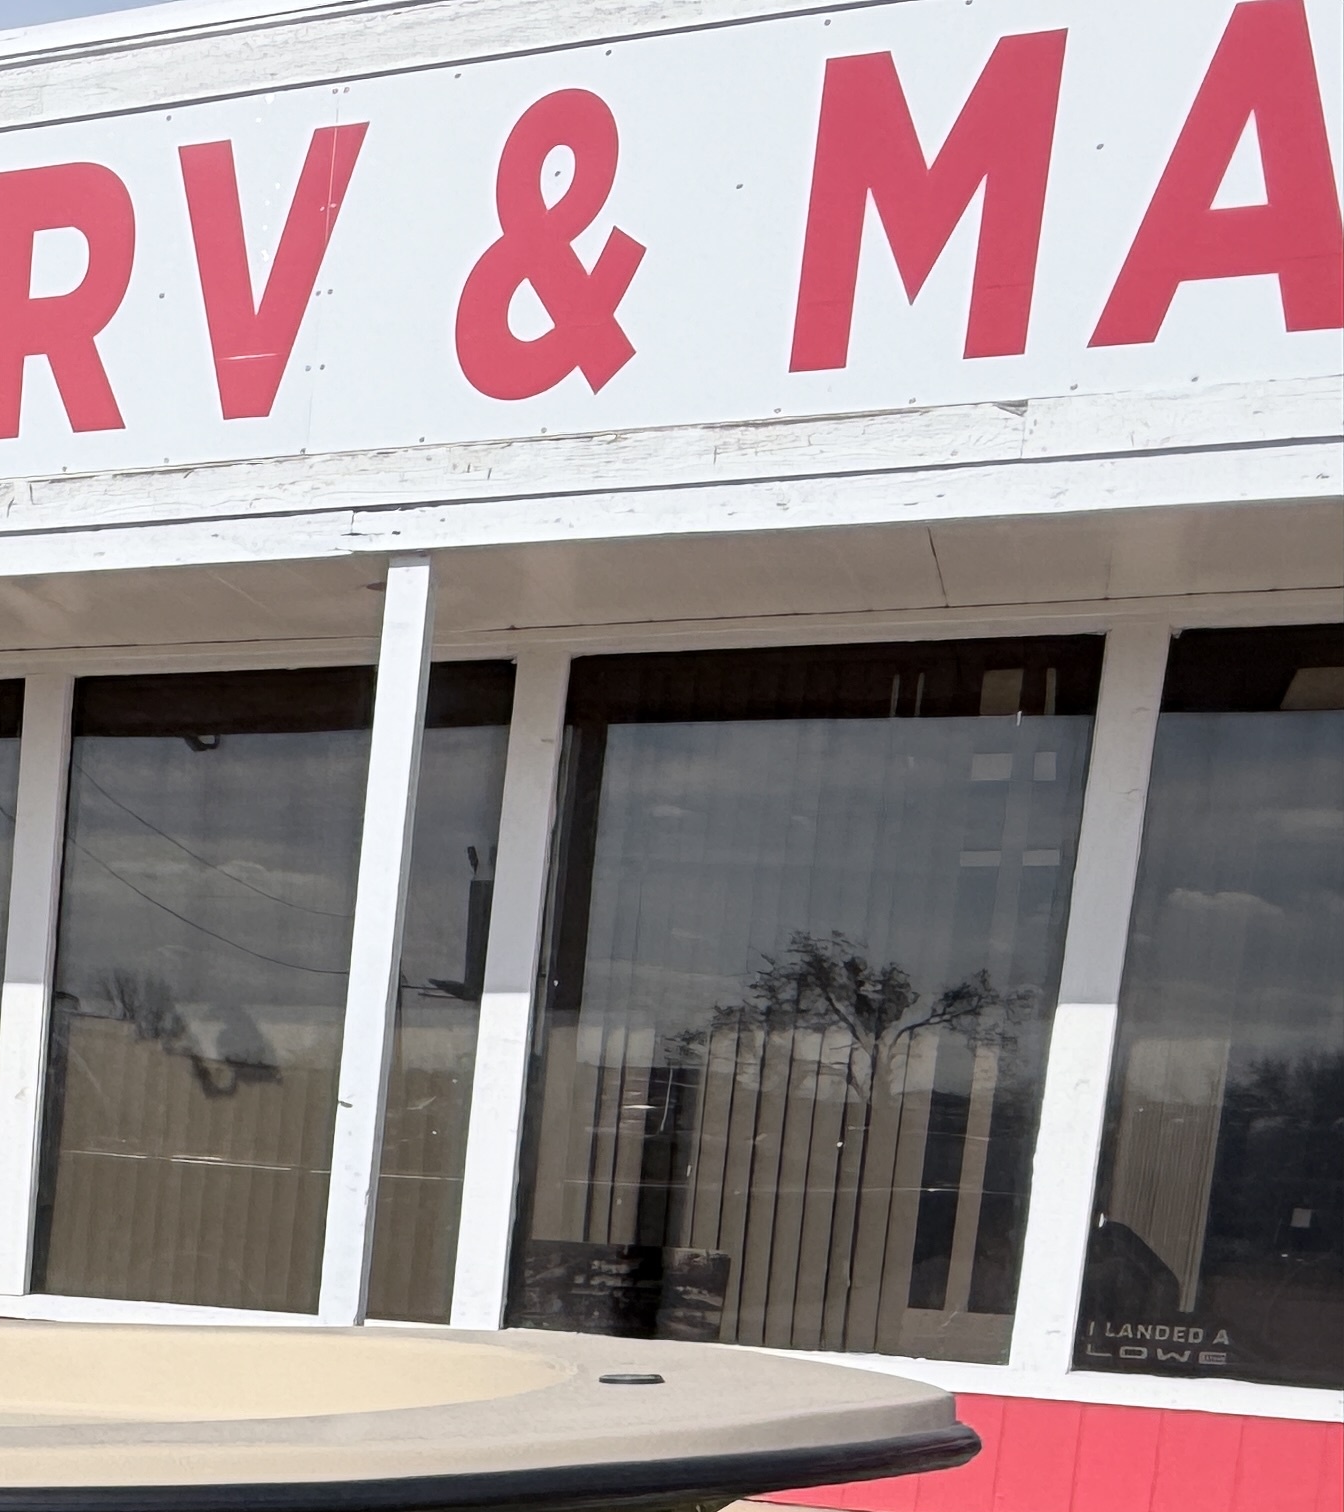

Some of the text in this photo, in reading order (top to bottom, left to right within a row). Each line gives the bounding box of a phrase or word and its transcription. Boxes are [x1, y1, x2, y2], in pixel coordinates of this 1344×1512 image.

[455, 88, 647, 400] &
[788, 0, 1344, 372] MA
[1105, 1321, 1204, 1345] LANDED
[1212, 1328, 1230, 1346] A
[1086, 1344, 1228, 1365] LOWE
